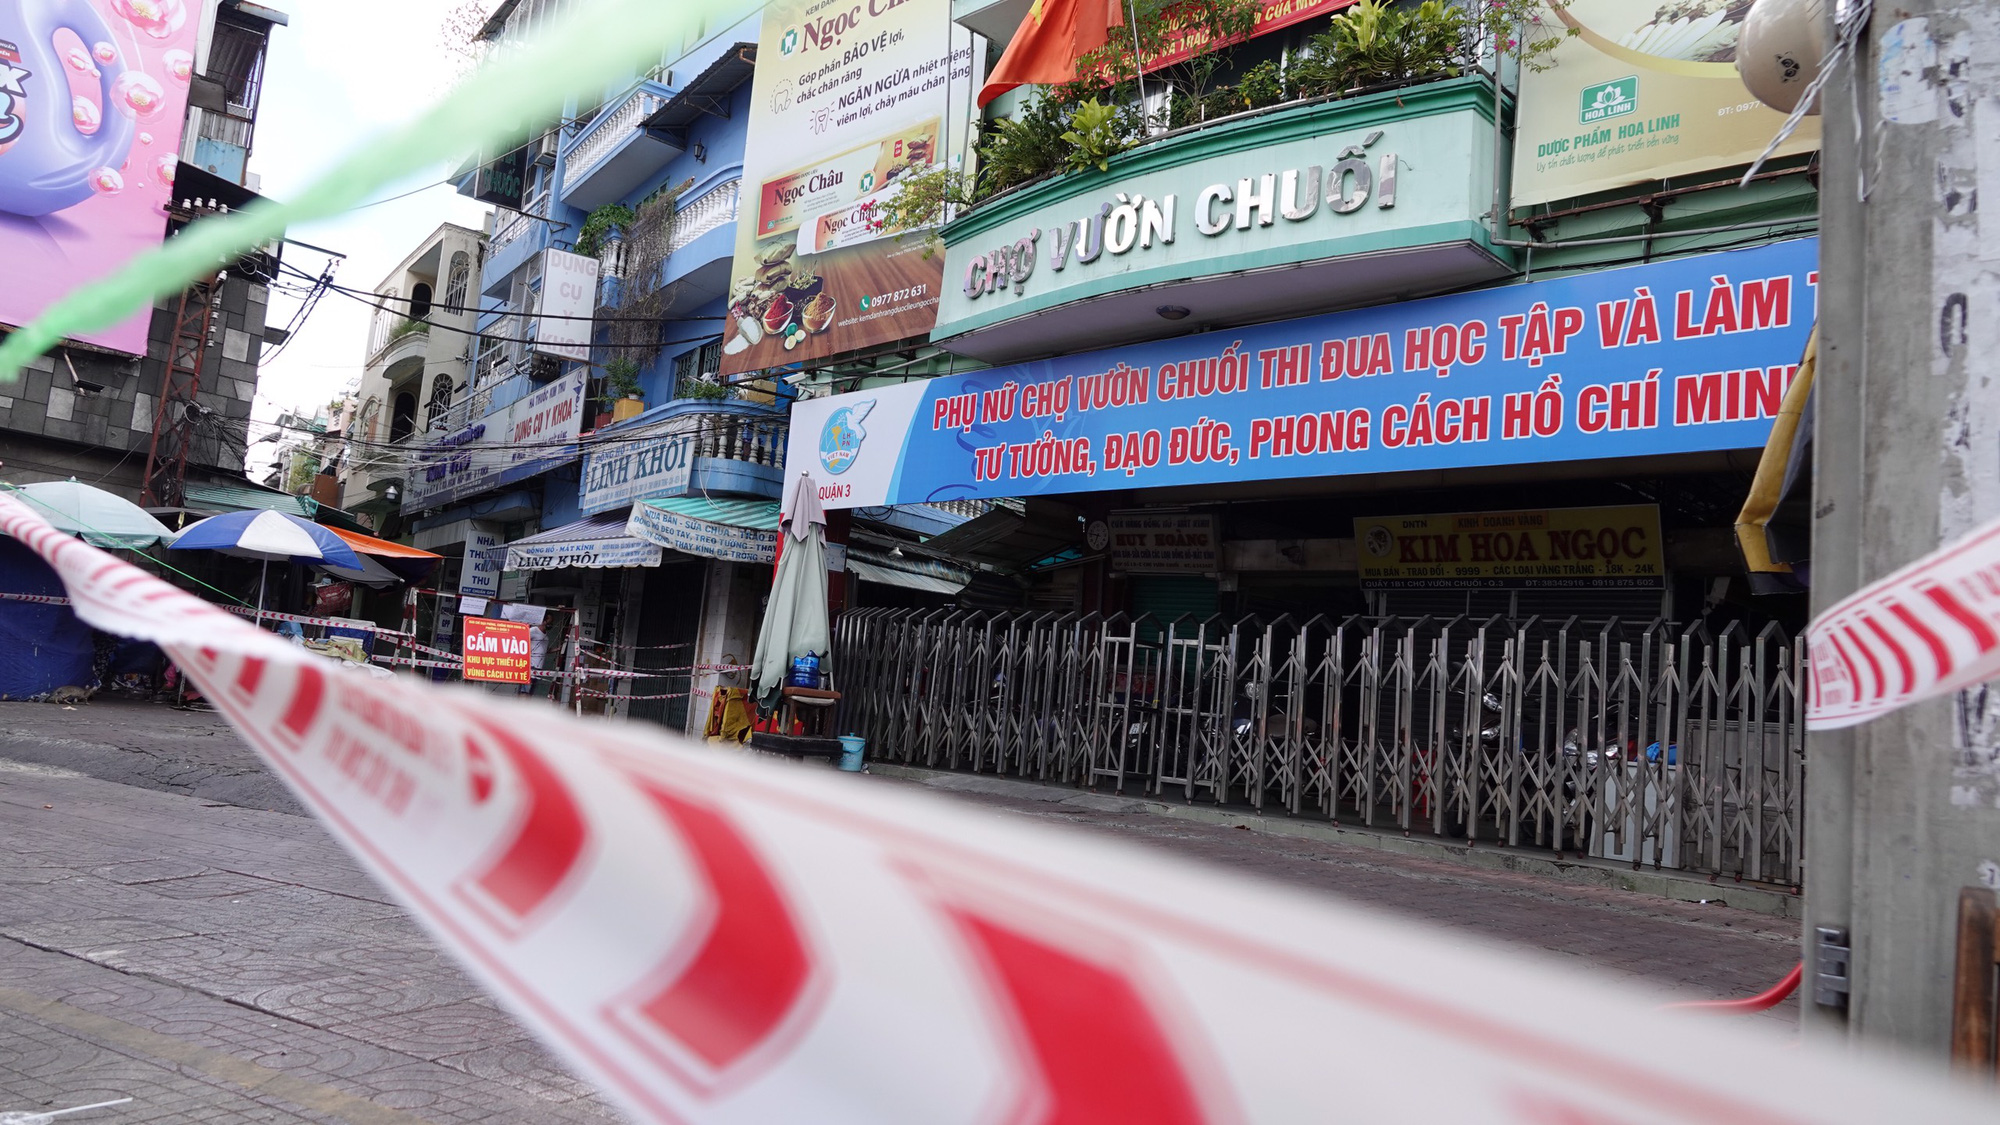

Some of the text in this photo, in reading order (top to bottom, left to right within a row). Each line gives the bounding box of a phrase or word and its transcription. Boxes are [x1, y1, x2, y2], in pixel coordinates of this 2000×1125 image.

[805, 3, 819, 17] KEM
[801, 5, 861, 53] Ngọc
[798, 28, 904, 87] Góp phần BẢO VỆ lợi,
[796, 67, 862, 104] chắc chân răng
[838, 59, 938, 110] NGĂN NGỪA nhiệt
[836, 112, 858, 127] viêm
[859, 103, 873, 119] lợi,
[875, 94, 897, 112] chảy
[898, 84, 919, 102] máu
[921, 74, 945, 92] chân
[1735, 100, 1760, 113] 0977
[1584, 102, 1631, 121] HOA LINH
[1537, 113, 1680, 158] DƯỢC PHẨM HOA LINH
[773, 184, 805, 206] Ngọc
[808, 169, 844, 193] Châu
[963, 130, 1399, 299] CHỢ VƯỜN CHUỐI
[823, 215, 848, 235] Ngọc
[551, 251, 597, 276] DỤNG
[560, 281, 583, 305] CỤ
[871, 283, 927, 307] 0977 872 631
[563, 309, 574, 326] Y
[838, 317, 859, 328] website:
[932, 393, 978, 433] PHỤ
[981, 382, 1020, 425] NỮ
[1020, 375, 1073, 422] CHỢ
[1077, 360, 1151, 412] VƯỜN
[1156, 339, 1250, 402] CHUỐI
[1258, 343, 1313, 390] THI
[1320, 332, 1393, 382] ĐUA
[1403, 319, 1487, 377] HỌC
[1498, 301, 1585, 368] TẬP
[1596, 285, 1662, 349] VÀ
[1673, 274, 1793, 340] LÀM
[545, 408, 551, 430] Y
[551, 397, 572, 427] KHOA
[974, 443, 1007, 482] TƯ
[1009, 430, 1096, 481] TƯỞNG,
[1103, 428, 1164, 477] ĐẠO
[1168, 416, 1240, 466] ĐỨC,
[1249, 407, 1371, 461] PHONG
[1380, 392, 1492, 450] CÁCH
[1501, 372, 1565, 440] HỒ
[1576, 367, 1664, 435] CHÍ
[588, 454, 631, 494] LINH
[634, 433, 690, 481] KHÔI
[818, 482, 851, 501] QUẬN 3
[645, 509, 661, 521] MUA
[662, 512, 678, 526] BÁN
[1402, 511, 1543, 529] DNTN KINH DOANH VÀNG
[661, 526, 675, 536] ĐEO
[676, 529, 693, 542] TAY,
[695, 534, 717, 545] TREO
[1115, 529, 1209, 547] HUY HOÀNG
[526, 543, 594, 554] ĐỒNG HỒ MẮT KÍNH
[674, 540, 715, 555] THAY KÍNH
[1397, 526, 1648, 565] KIM HOA NGỌC
[517, 556, 552, 568] LINH
[557, 550, 600, 567] KHÔI
[1364, 568, 1381, 577] MUA
[1383, 565, 1400, 577] BÁN
[1406, 566, 1428, 577] TRAO
[1429, 563, 1445, 576] ĐỔI
[1455, 566, 1480, 576] 9999
[1493, 563, 1511, 576] CÁC
[1513, 564, 1534, 577] LOẠI
[1535, 563, 1561, 575] VÀNG
[1605, 564, 1624, 574] 18K
[1635, 563, 1655, 573] 24K
[472, 575, 490, 586] THU
[1391, 580, 1405, 588] 1B1
[1407, 580, 1426, 588] CHỢ
[1427, 578, 1452, 588] VƯỜN
[1454, 577, 1482, 588] CHUỐI
[1488, 580, 1504, 588] Q.3
[1592, 579, 1615, 587] 0919
[1616, 579, 1634, 587] 875
[466, 631, 528, 655] CẤM VÀO
[467, 655, 528, 669] KHU VỰC THIẾT LẬP
[467, 667, 528, 681] VÙNG CÁCH LY Y TẾ
